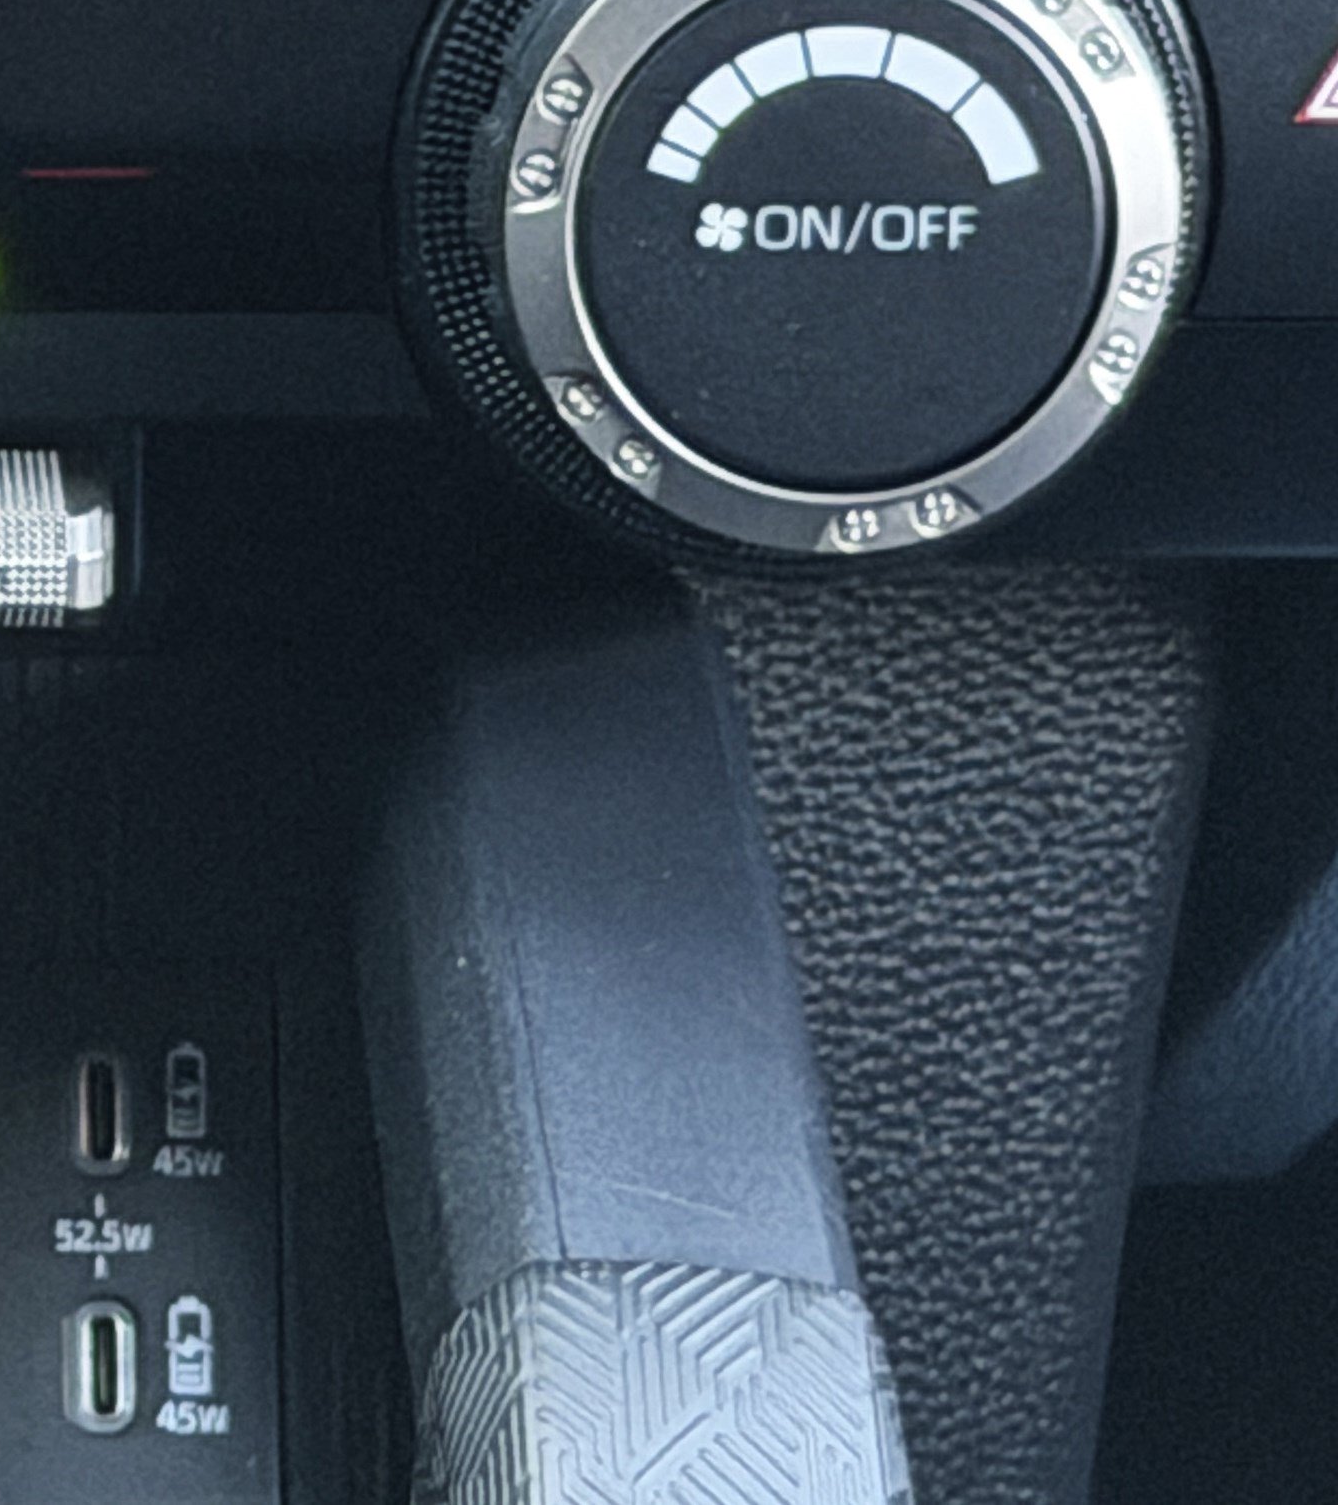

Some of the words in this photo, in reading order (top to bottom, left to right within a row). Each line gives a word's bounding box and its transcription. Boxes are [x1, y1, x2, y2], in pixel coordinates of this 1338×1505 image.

[754, 202, 979, 254] ON/OFF
[152, 1145, 222, 1177] 45W
[55, 1218, 152, 1253] 52.5W
[155, 1399, 228, 1435] 45W
